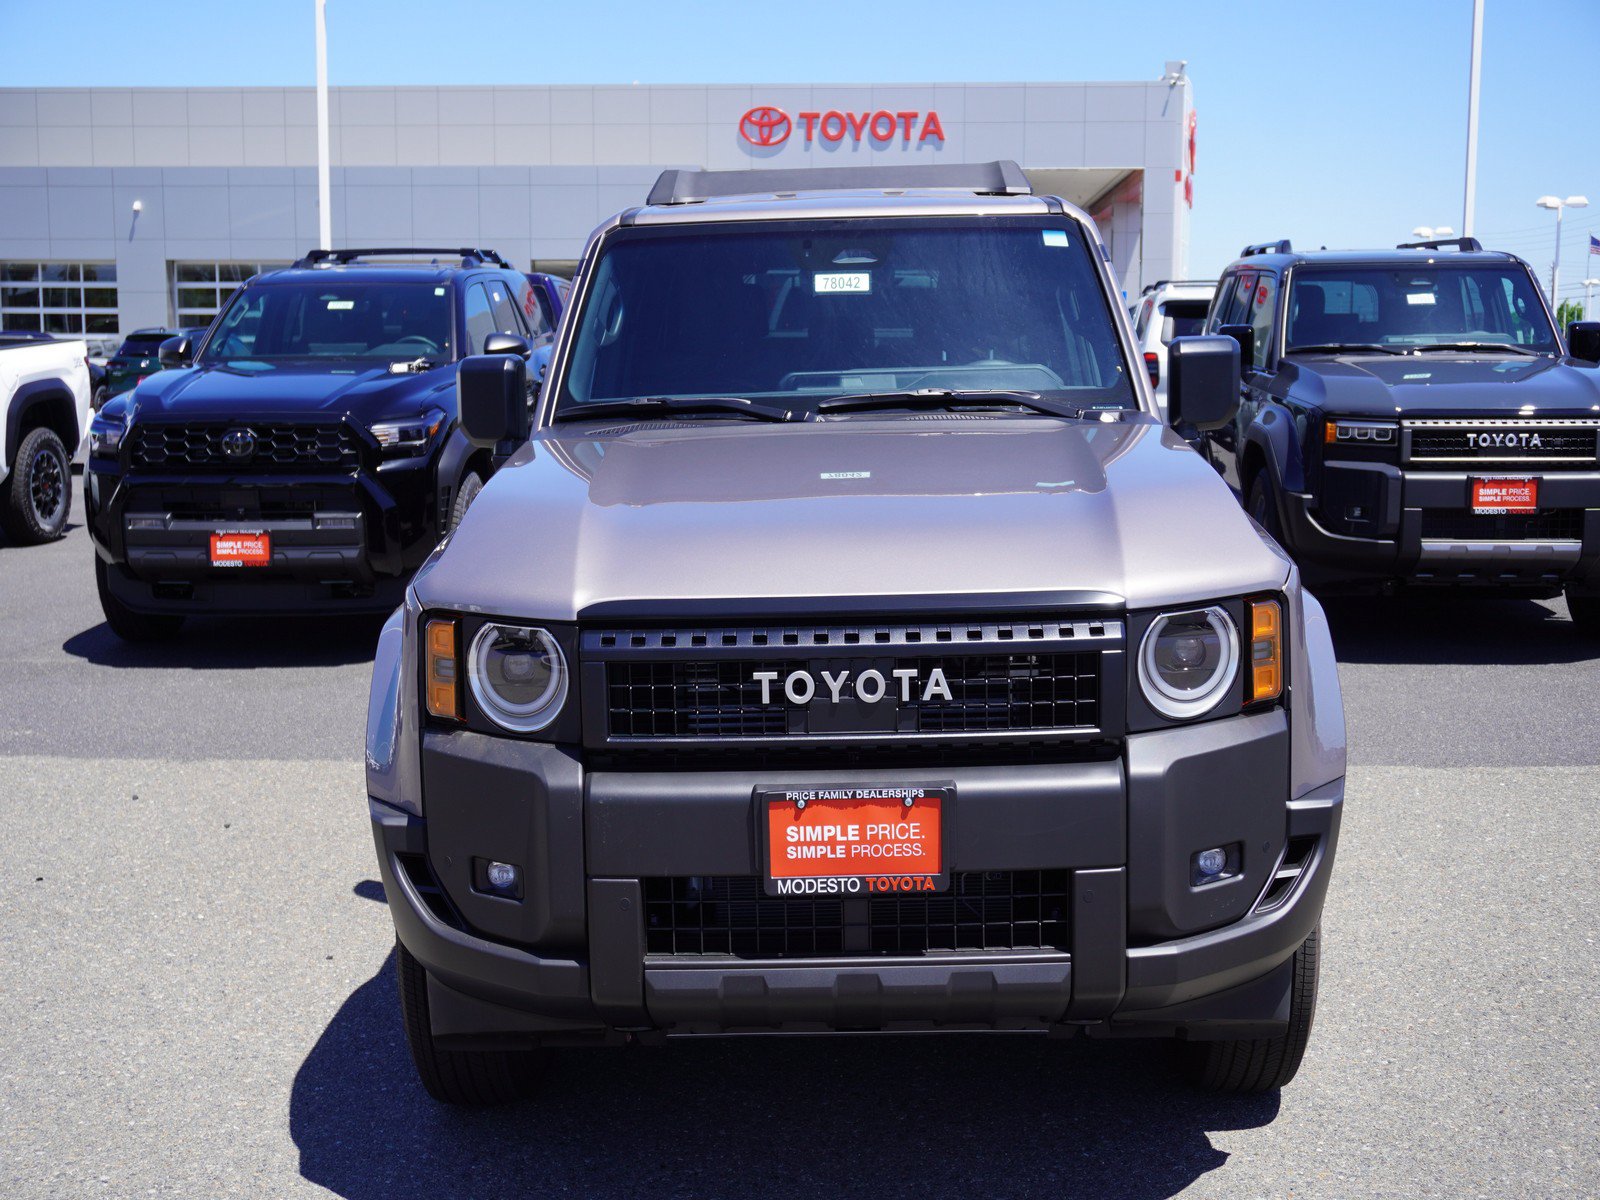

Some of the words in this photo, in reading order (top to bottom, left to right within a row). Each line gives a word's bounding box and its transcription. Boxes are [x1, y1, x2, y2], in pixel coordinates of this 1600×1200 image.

[799, 110, 945, 142] TOYOTA
[822, 276, 861, 290] 78042
[1466, 433, 1542, 447] TOYOTA
[1508, 487, 1531, 495] PRICE.
[752, 668, 953, 705] TOYOTA
[786, 791, 816, 801] PRICE
[818, 790, 853, 800] FAMILY
[856, 789, 925, 799] DEALERSHIPS
[786, 824, 860, 842] SIMPLE
[866, 823, 926, 840] PRICE.
[786, 845, 846, 859] SIMPLE
[851, 843, 926, 858] PROCESS.
[777, 877, 860, 895] MODESTO
[865, 876, 936, 892] TOYOTA
